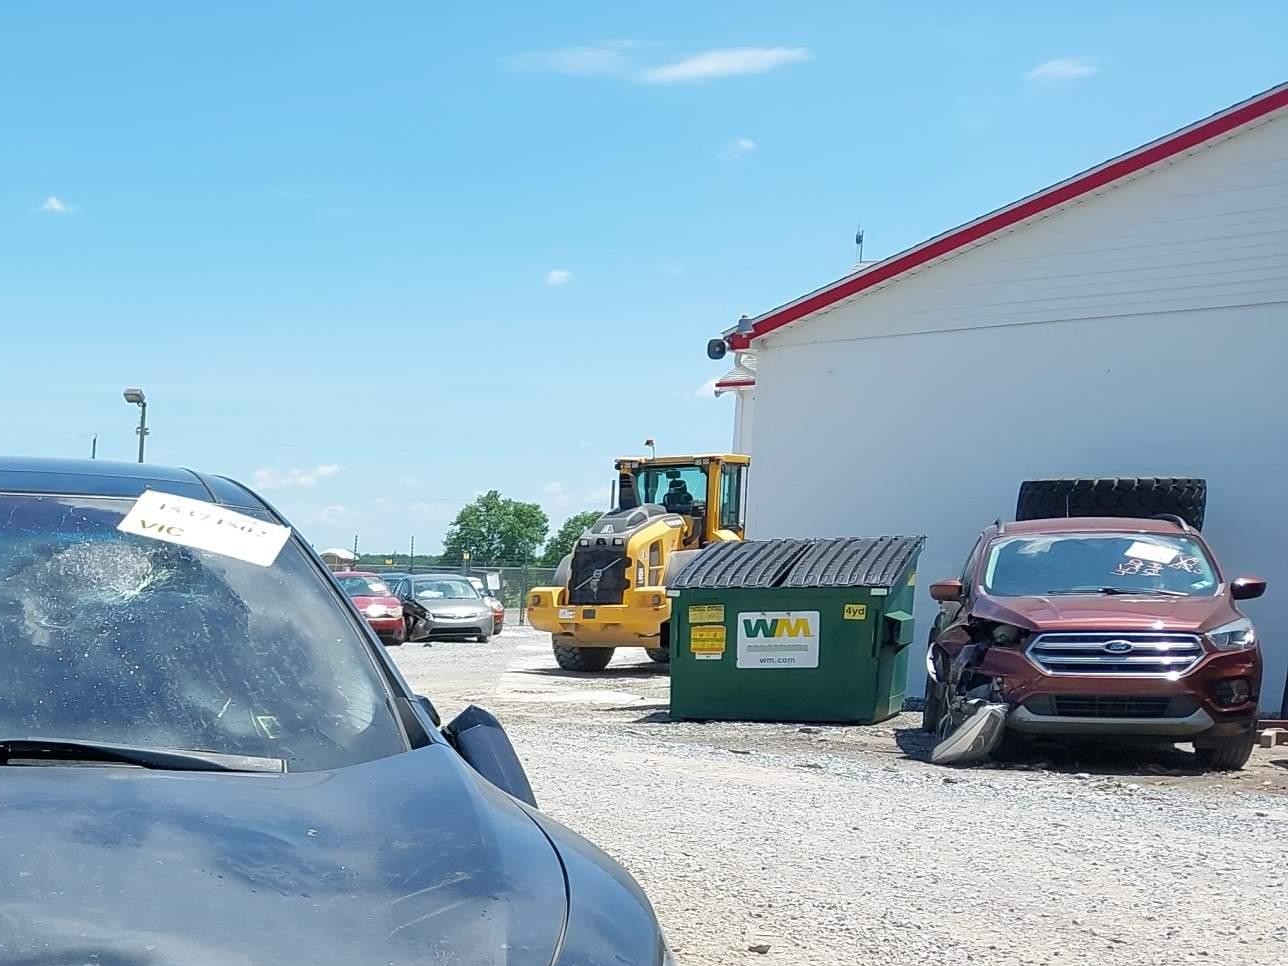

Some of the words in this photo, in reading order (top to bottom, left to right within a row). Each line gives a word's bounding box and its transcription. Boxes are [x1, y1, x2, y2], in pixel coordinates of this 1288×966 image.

[139, 519, 185, 537] VIC
[845, 606, 866, 617] 4yd
[743, 618, 811, 637] WM
